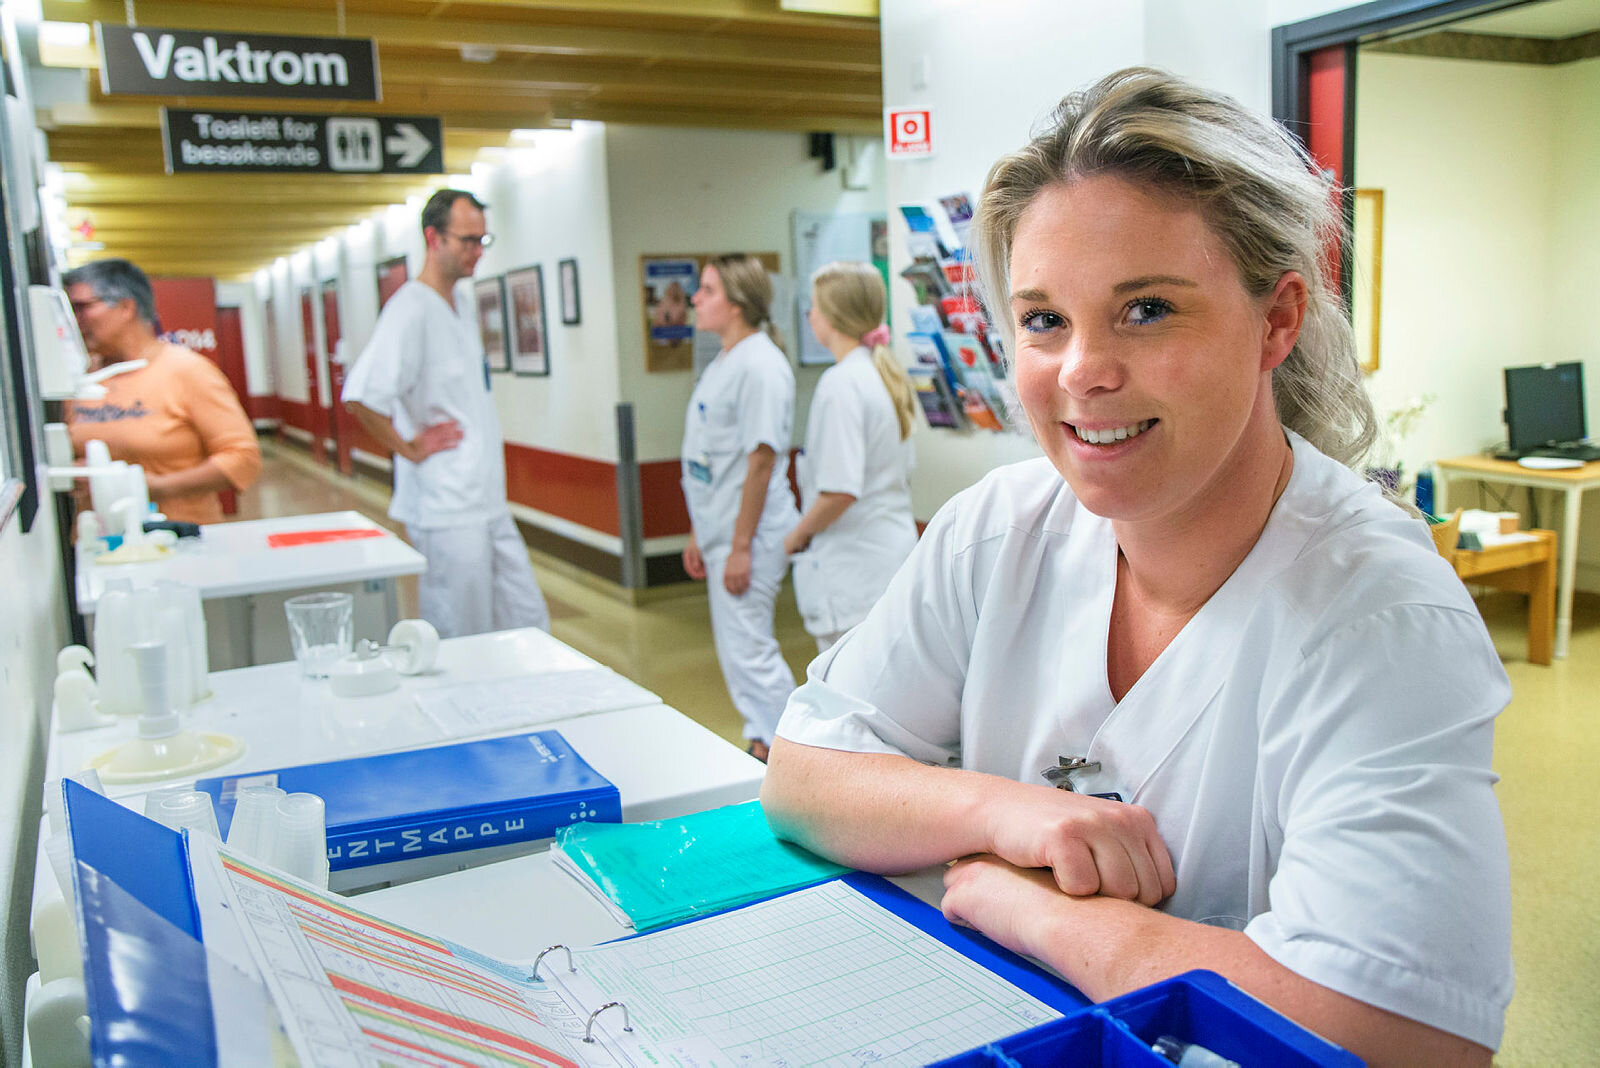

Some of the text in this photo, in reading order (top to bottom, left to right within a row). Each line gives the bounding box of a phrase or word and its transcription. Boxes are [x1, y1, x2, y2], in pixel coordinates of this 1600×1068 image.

[132, 32, 348, 86] Vaktrom
[192, 114, 318, 141] Toalett for
[181, 139, 320, 167] besøkende
